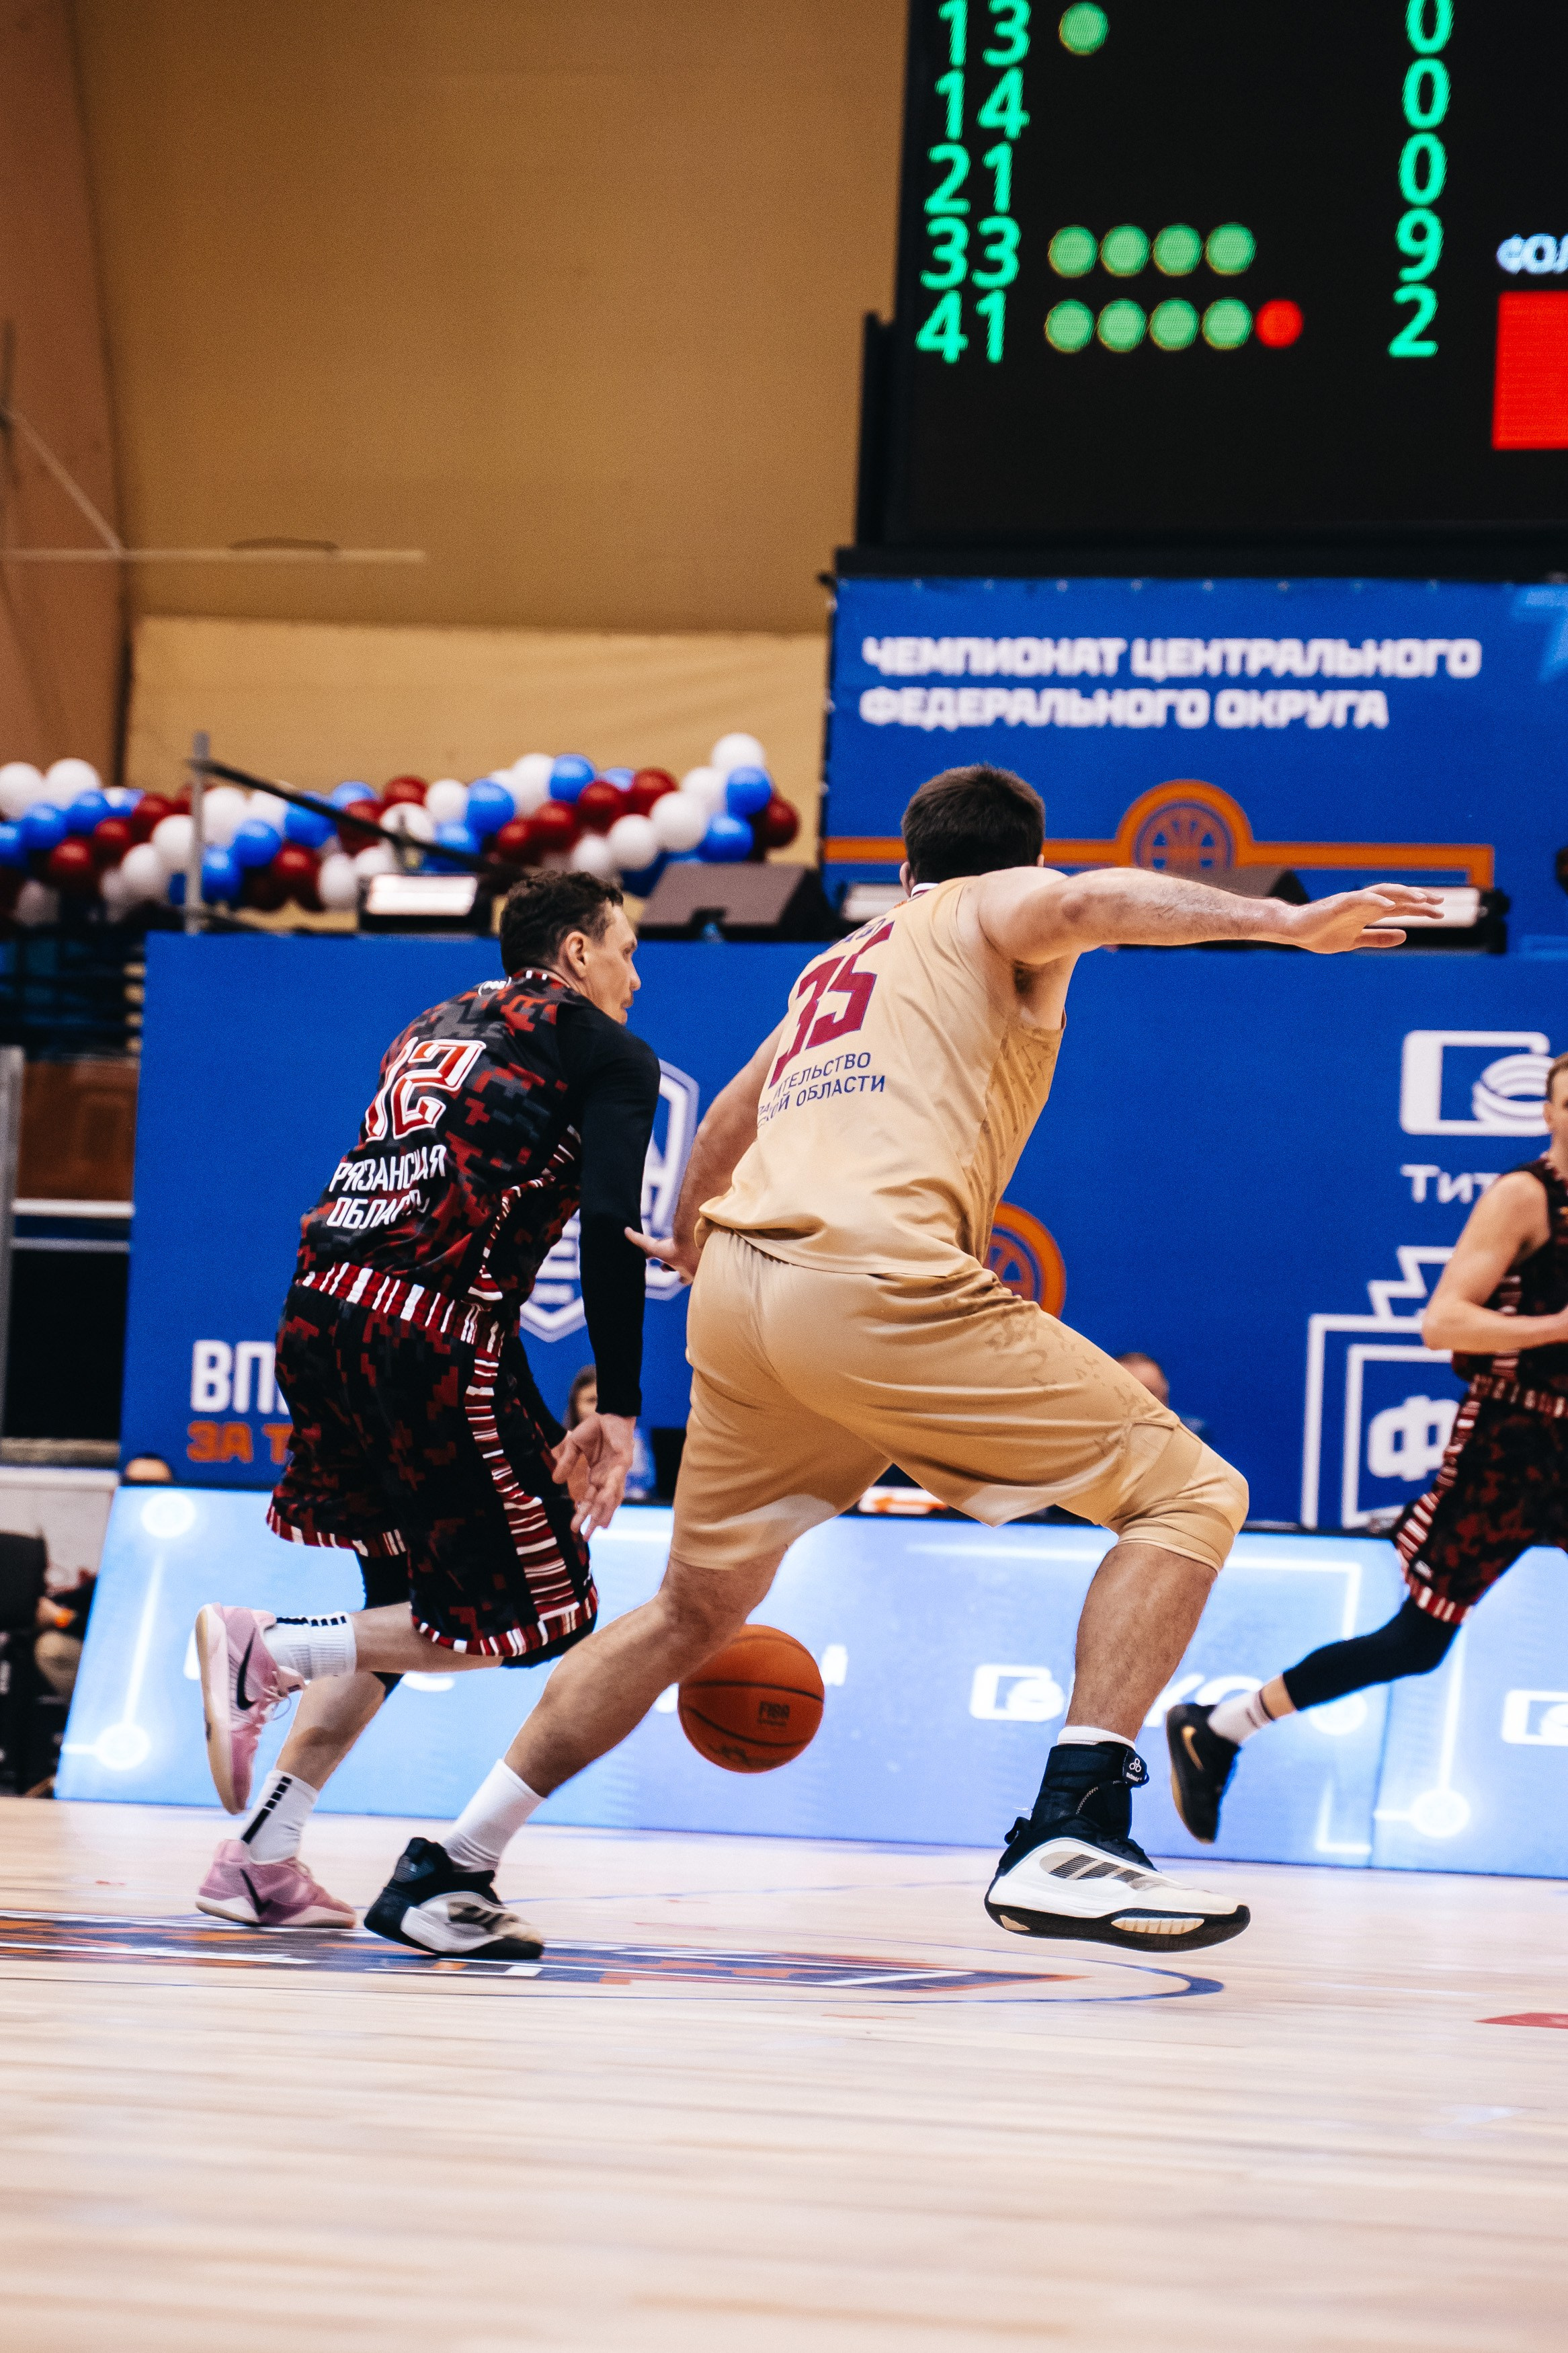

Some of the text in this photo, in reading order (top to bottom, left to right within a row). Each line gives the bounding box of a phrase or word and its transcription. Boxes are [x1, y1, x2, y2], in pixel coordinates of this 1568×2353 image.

[939, 0, 1454, 67] 13 0
[936, 58, 1450, 140] 14 0
[924, 132, 1447, 214] 21 0
[921, 208, 1444, 289] 33 9
[915, 284, 1438, 363] 41 2
[862, 637, 1481, 680] ЧЕМПИОНАТ ЦЕНТРАЛЬНОГО
[860, 687, 1389, 730] ФЕДЕРАЛЬНОГО ОКРУГА
[768, 920, 895, 1089] 35
[365, 1037, 487, 1142] 12
[796, 1075, 886, 1107] ОБЛАСТИ
[191, 1340, 289, 1414] ВП
[188, 1421, 253, 1462] ЗА
